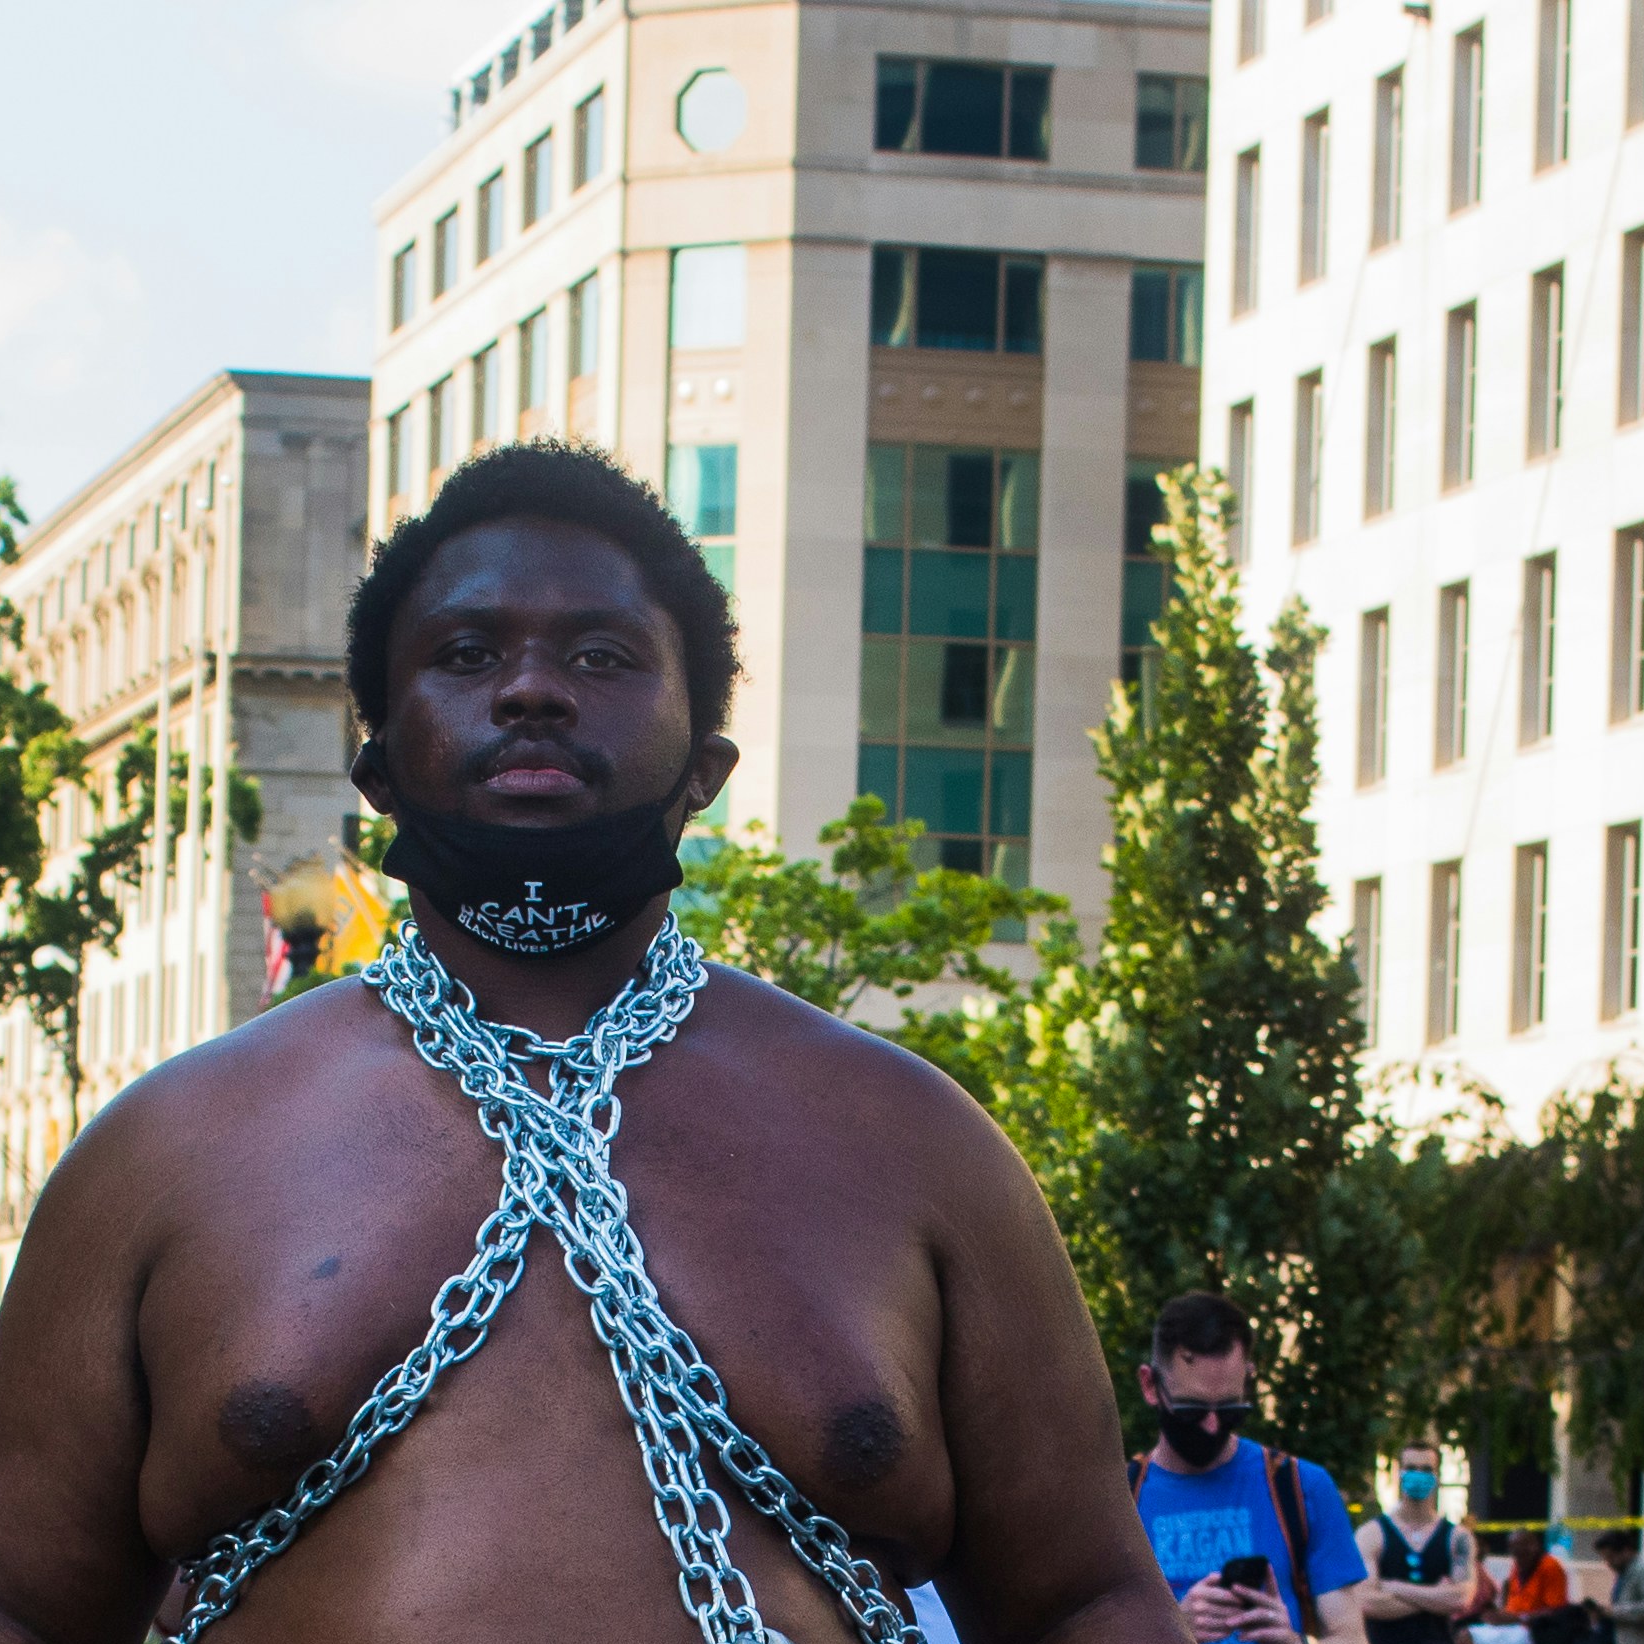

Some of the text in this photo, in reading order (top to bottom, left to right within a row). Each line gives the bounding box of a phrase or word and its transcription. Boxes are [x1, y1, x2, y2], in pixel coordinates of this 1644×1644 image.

[524, 881, 543, 902] I
[480, 901, 588, 926] CAN'T
[504, 939, 549, 953] LIVES
[1154, 1527, 1253, 1561] KAGAN
